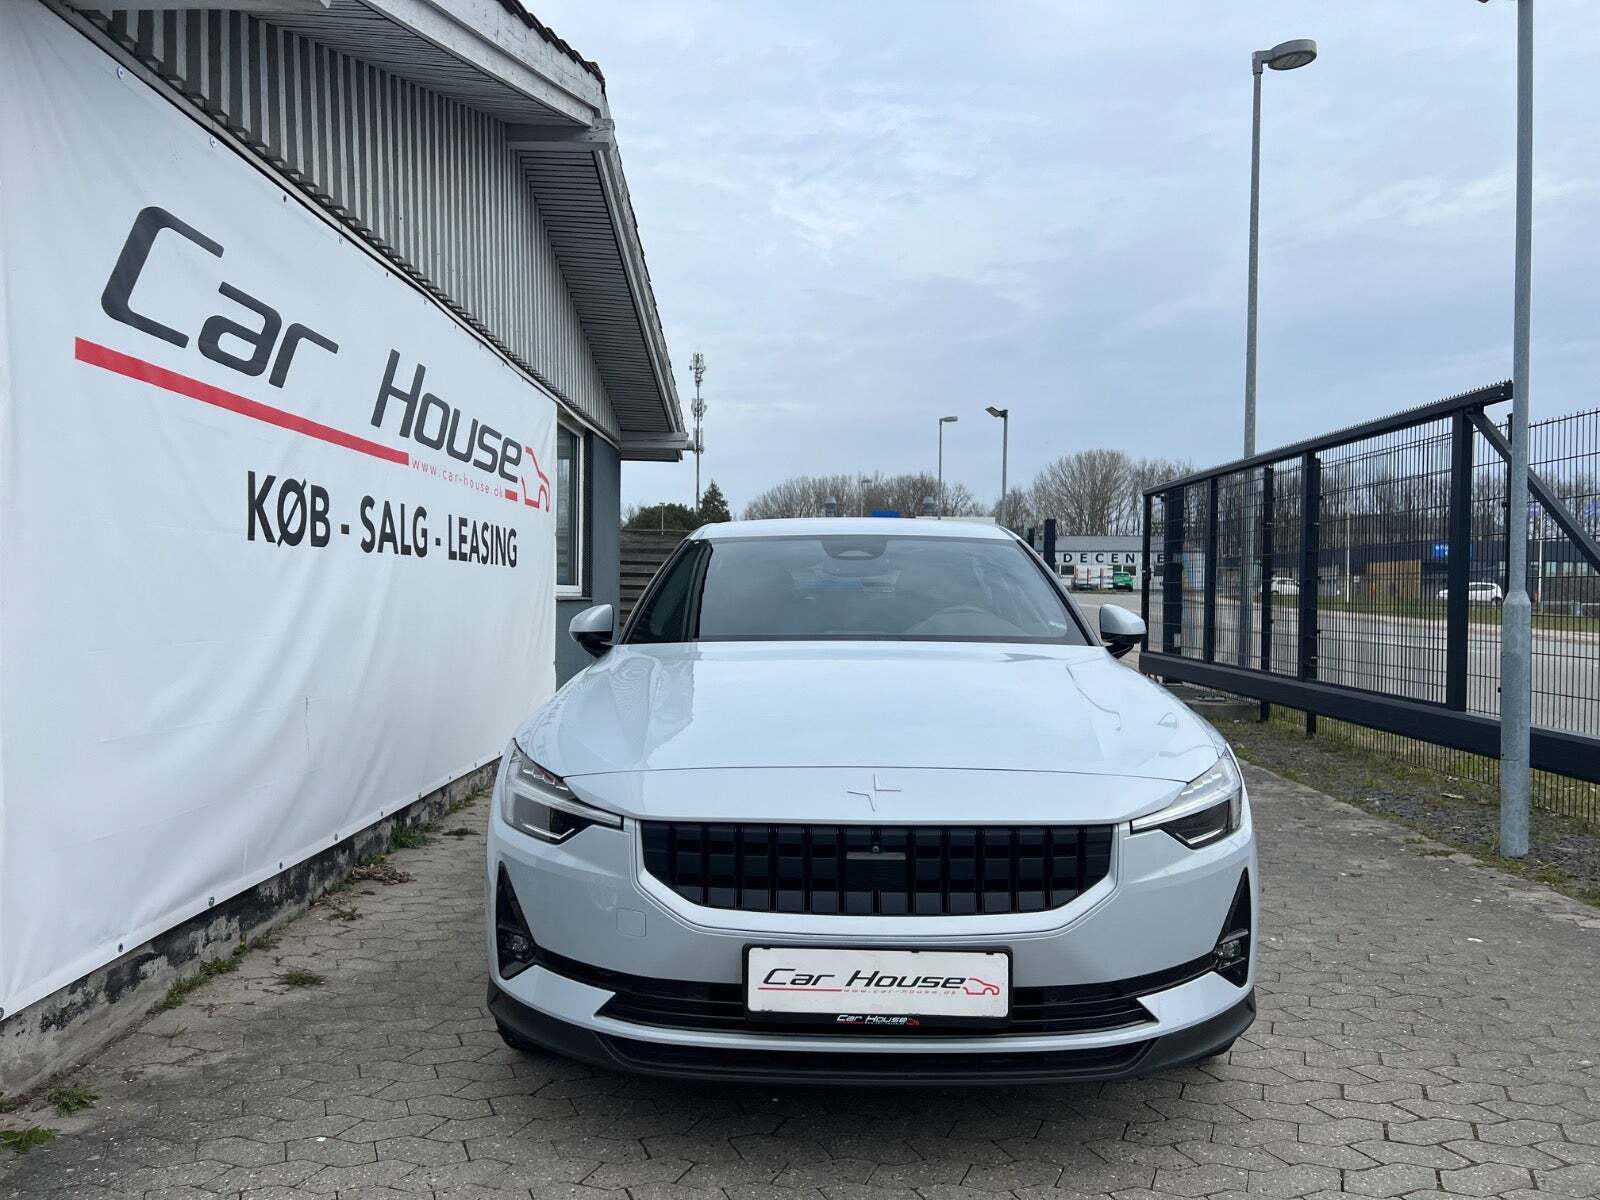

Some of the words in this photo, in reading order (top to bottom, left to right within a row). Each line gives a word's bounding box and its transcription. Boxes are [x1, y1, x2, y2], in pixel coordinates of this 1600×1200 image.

[101, 206, 339, 389] Car
[370, 348, 522, 484] House
[247, 470, 331, 548] KØB
[359, 495, 428, 558] SALG
[448, 514, 518, 568] LEASING
[762, 968, 835, 986] Car
[845, 969, 967, 989] House
[836, 1014, 863, 1022] Car
[864, 1015, 908, 1023] House
